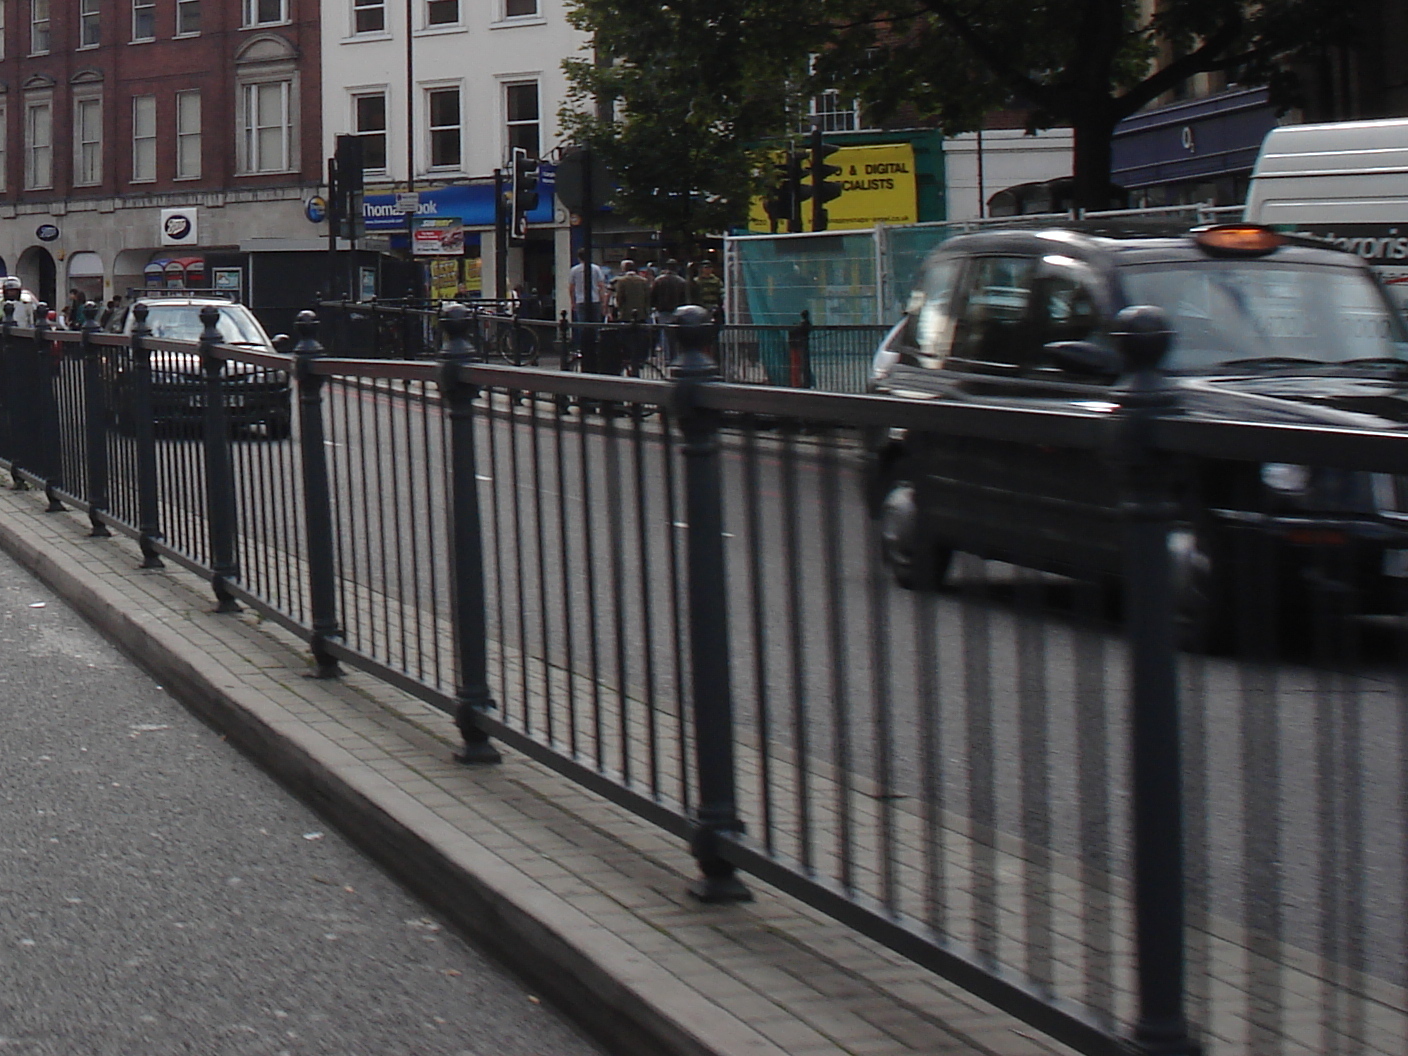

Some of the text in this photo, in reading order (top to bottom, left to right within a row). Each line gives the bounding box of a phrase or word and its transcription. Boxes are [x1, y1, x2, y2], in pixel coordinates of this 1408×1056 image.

[849, 165, 857, 175] &
[865, 162, 910, 175] DIGITAL
[842, 179, 895, 191] CIALISTS
